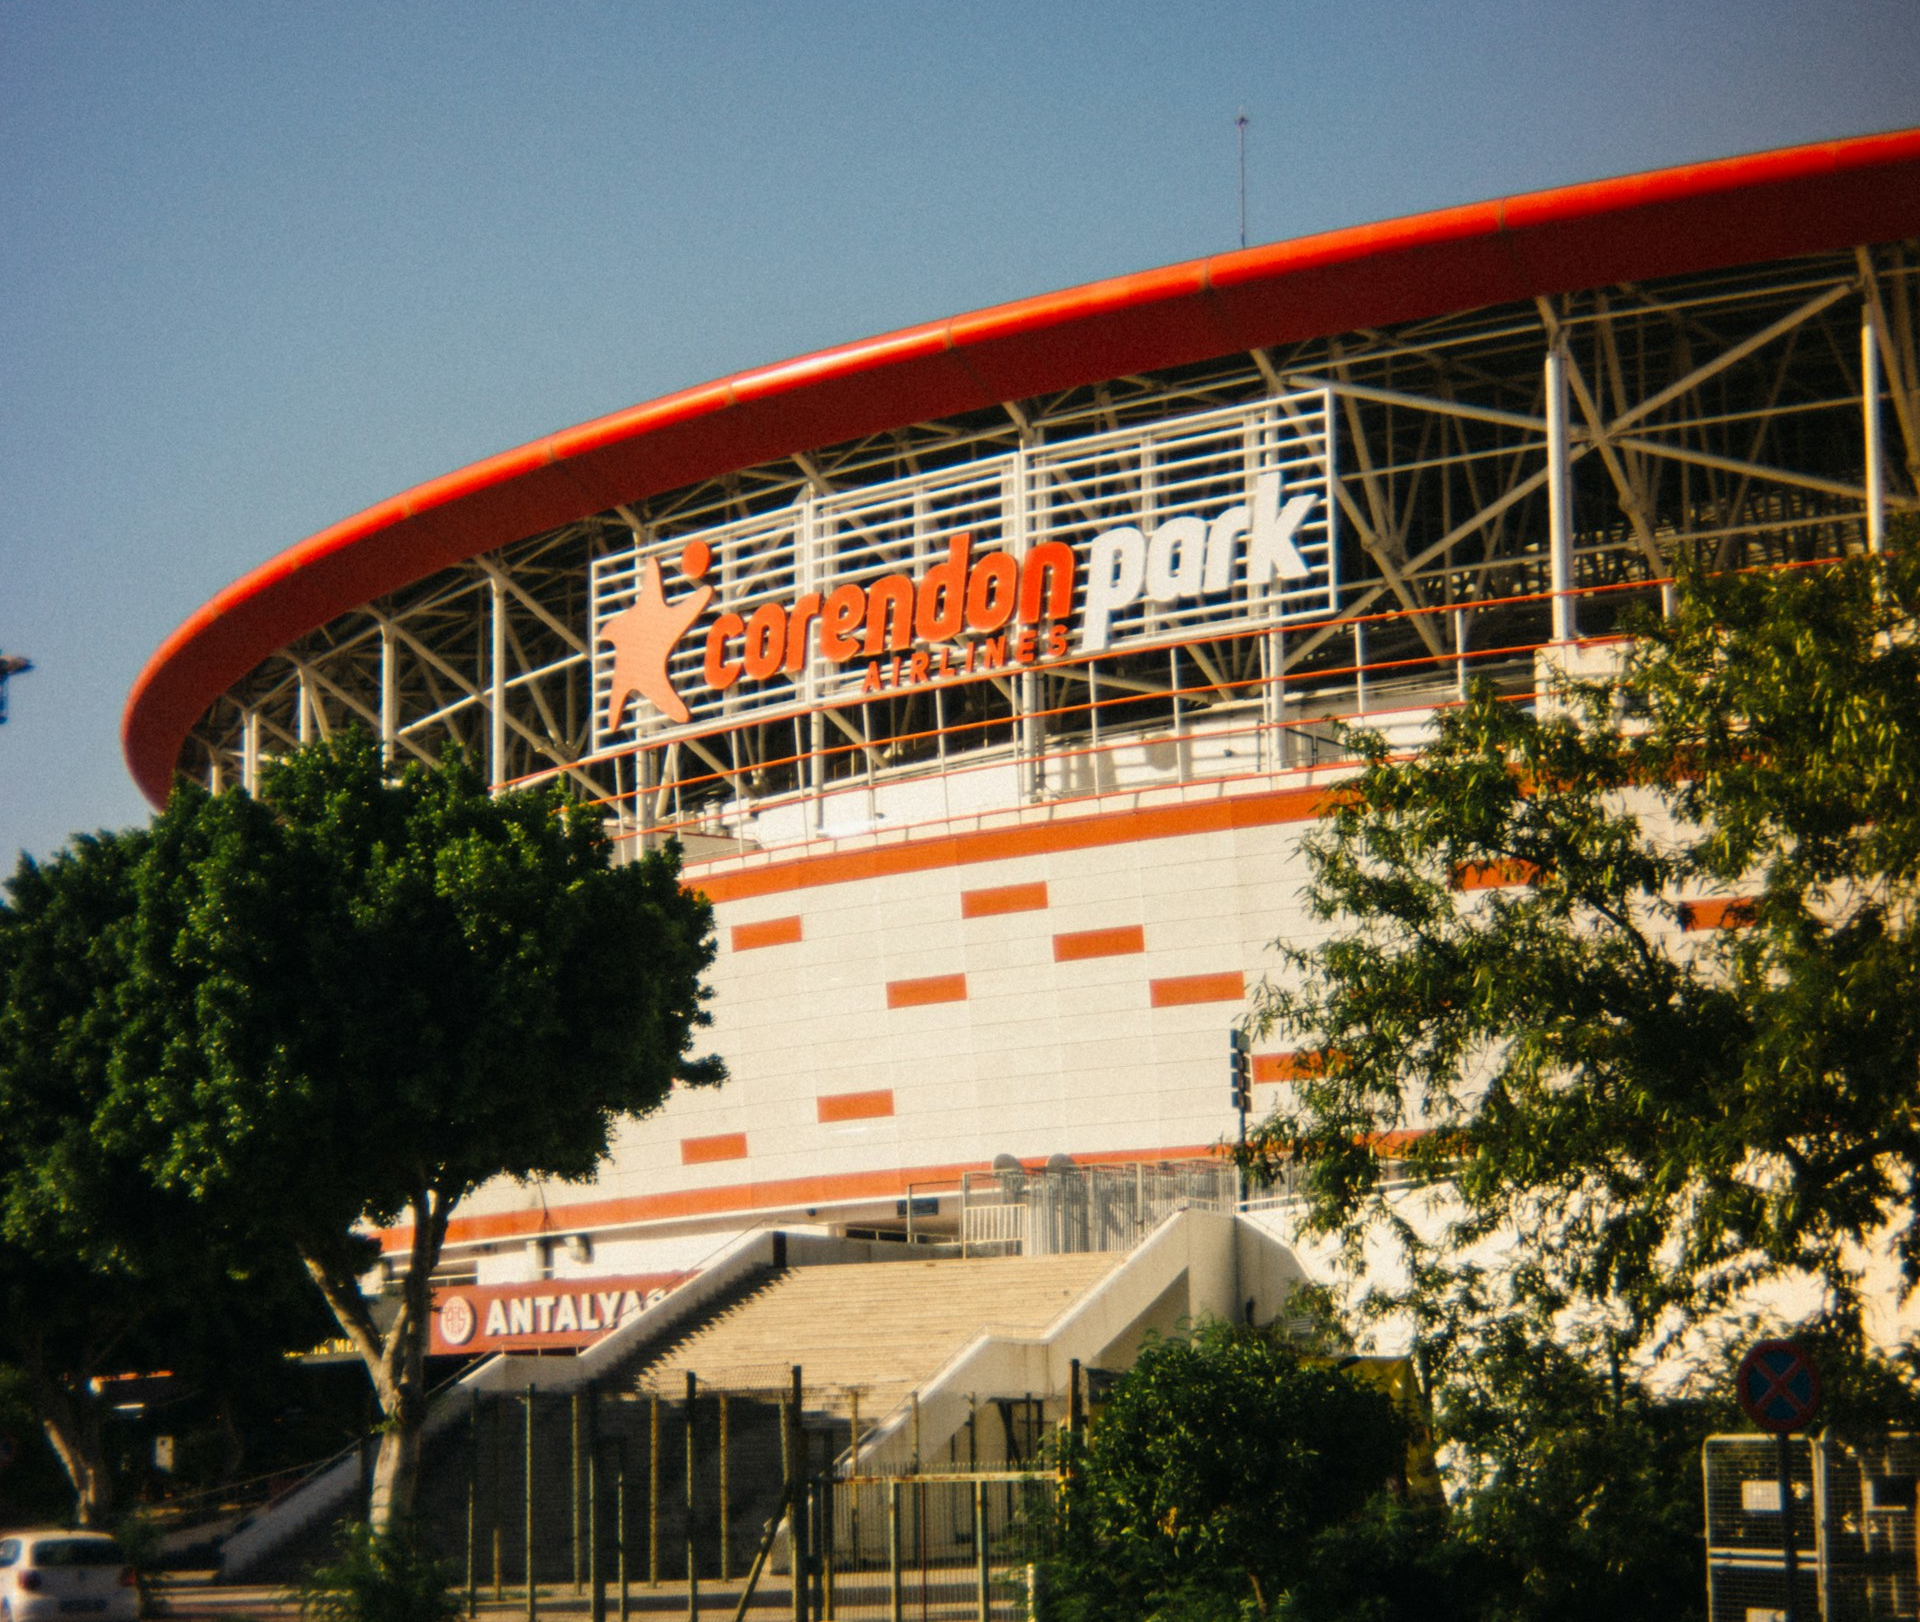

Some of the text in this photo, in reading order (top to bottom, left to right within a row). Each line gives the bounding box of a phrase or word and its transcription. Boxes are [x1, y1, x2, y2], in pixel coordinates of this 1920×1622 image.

[704, 473, 1317, 690] corendon park
[862, 627, 1069, 692] AIRLINES
